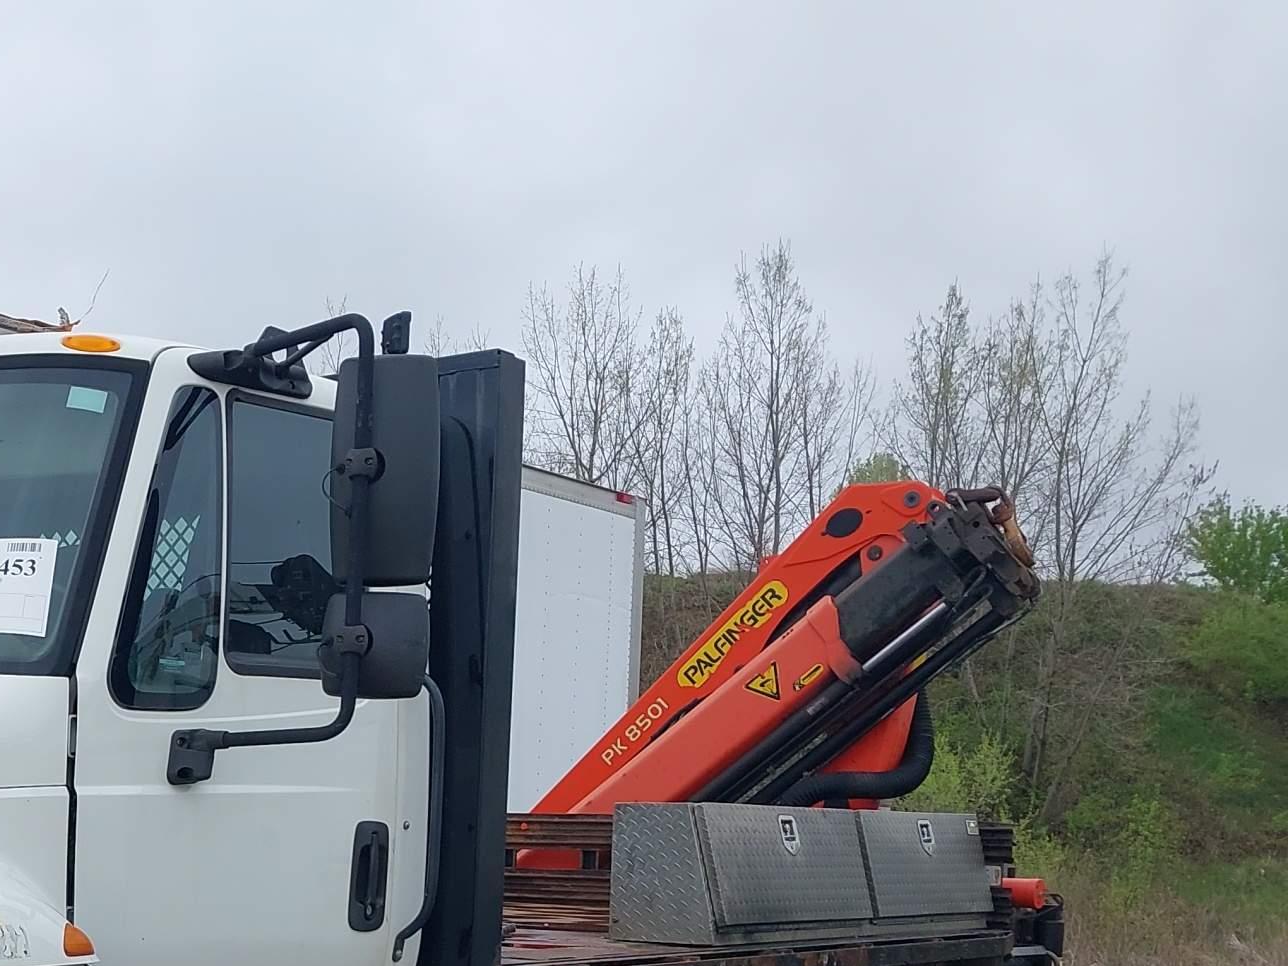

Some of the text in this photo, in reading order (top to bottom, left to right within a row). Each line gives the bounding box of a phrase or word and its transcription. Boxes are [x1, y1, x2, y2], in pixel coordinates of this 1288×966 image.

[682, 586, 783, 685] PALFINGER
[601, 697, 670, 765] PK 8501
